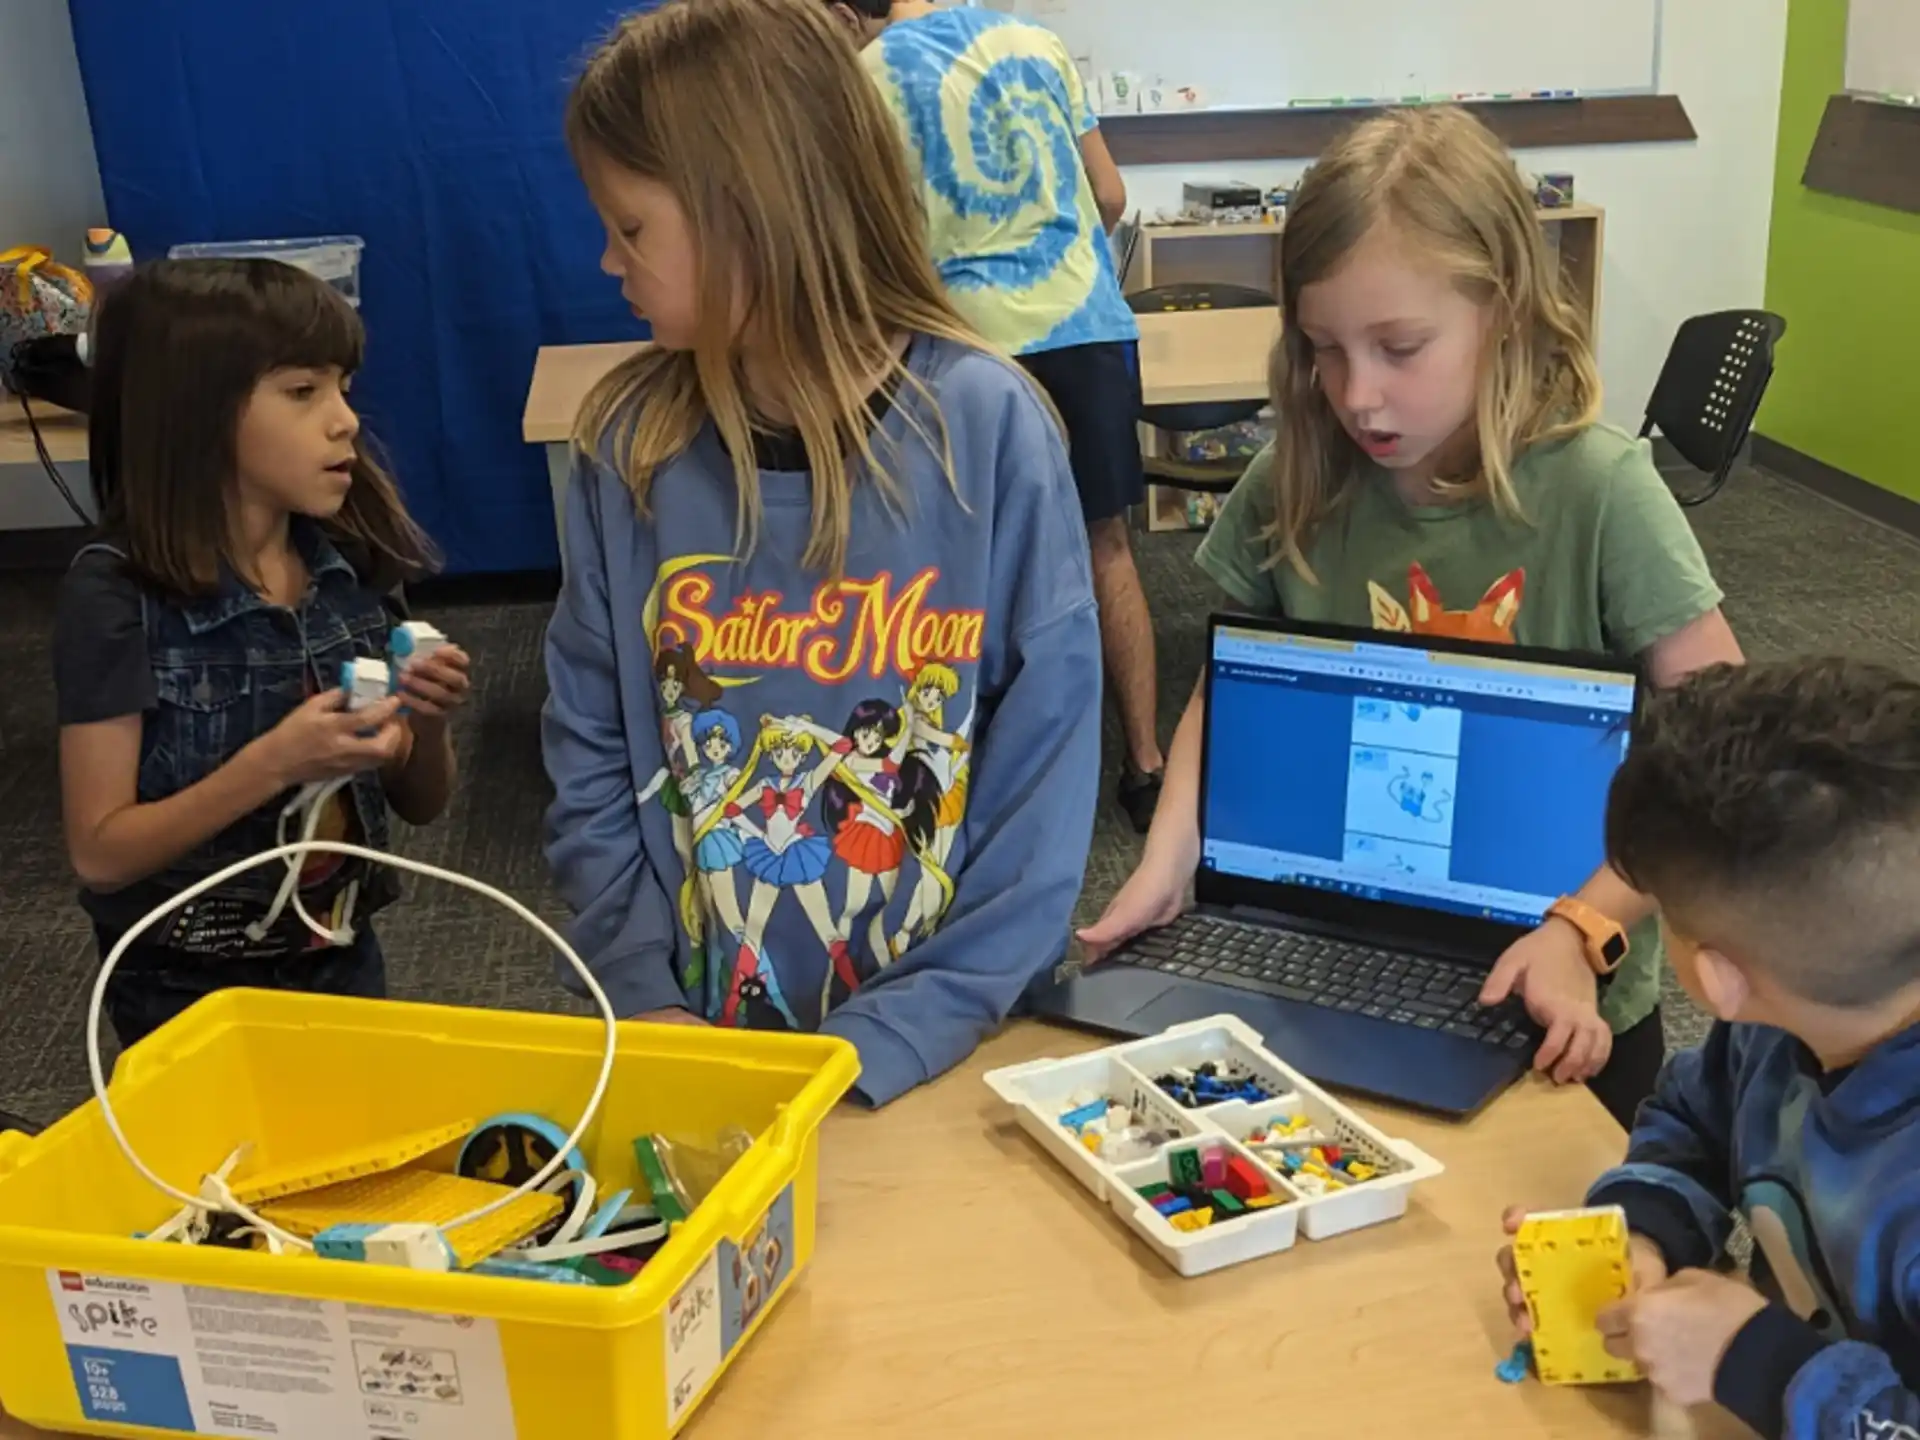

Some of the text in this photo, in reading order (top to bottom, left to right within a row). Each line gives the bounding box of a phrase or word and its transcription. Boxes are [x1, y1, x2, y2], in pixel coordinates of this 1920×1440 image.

[654, 566, 986, 685] Sailor Moon
[68, 1299, 158, 1336] spike
